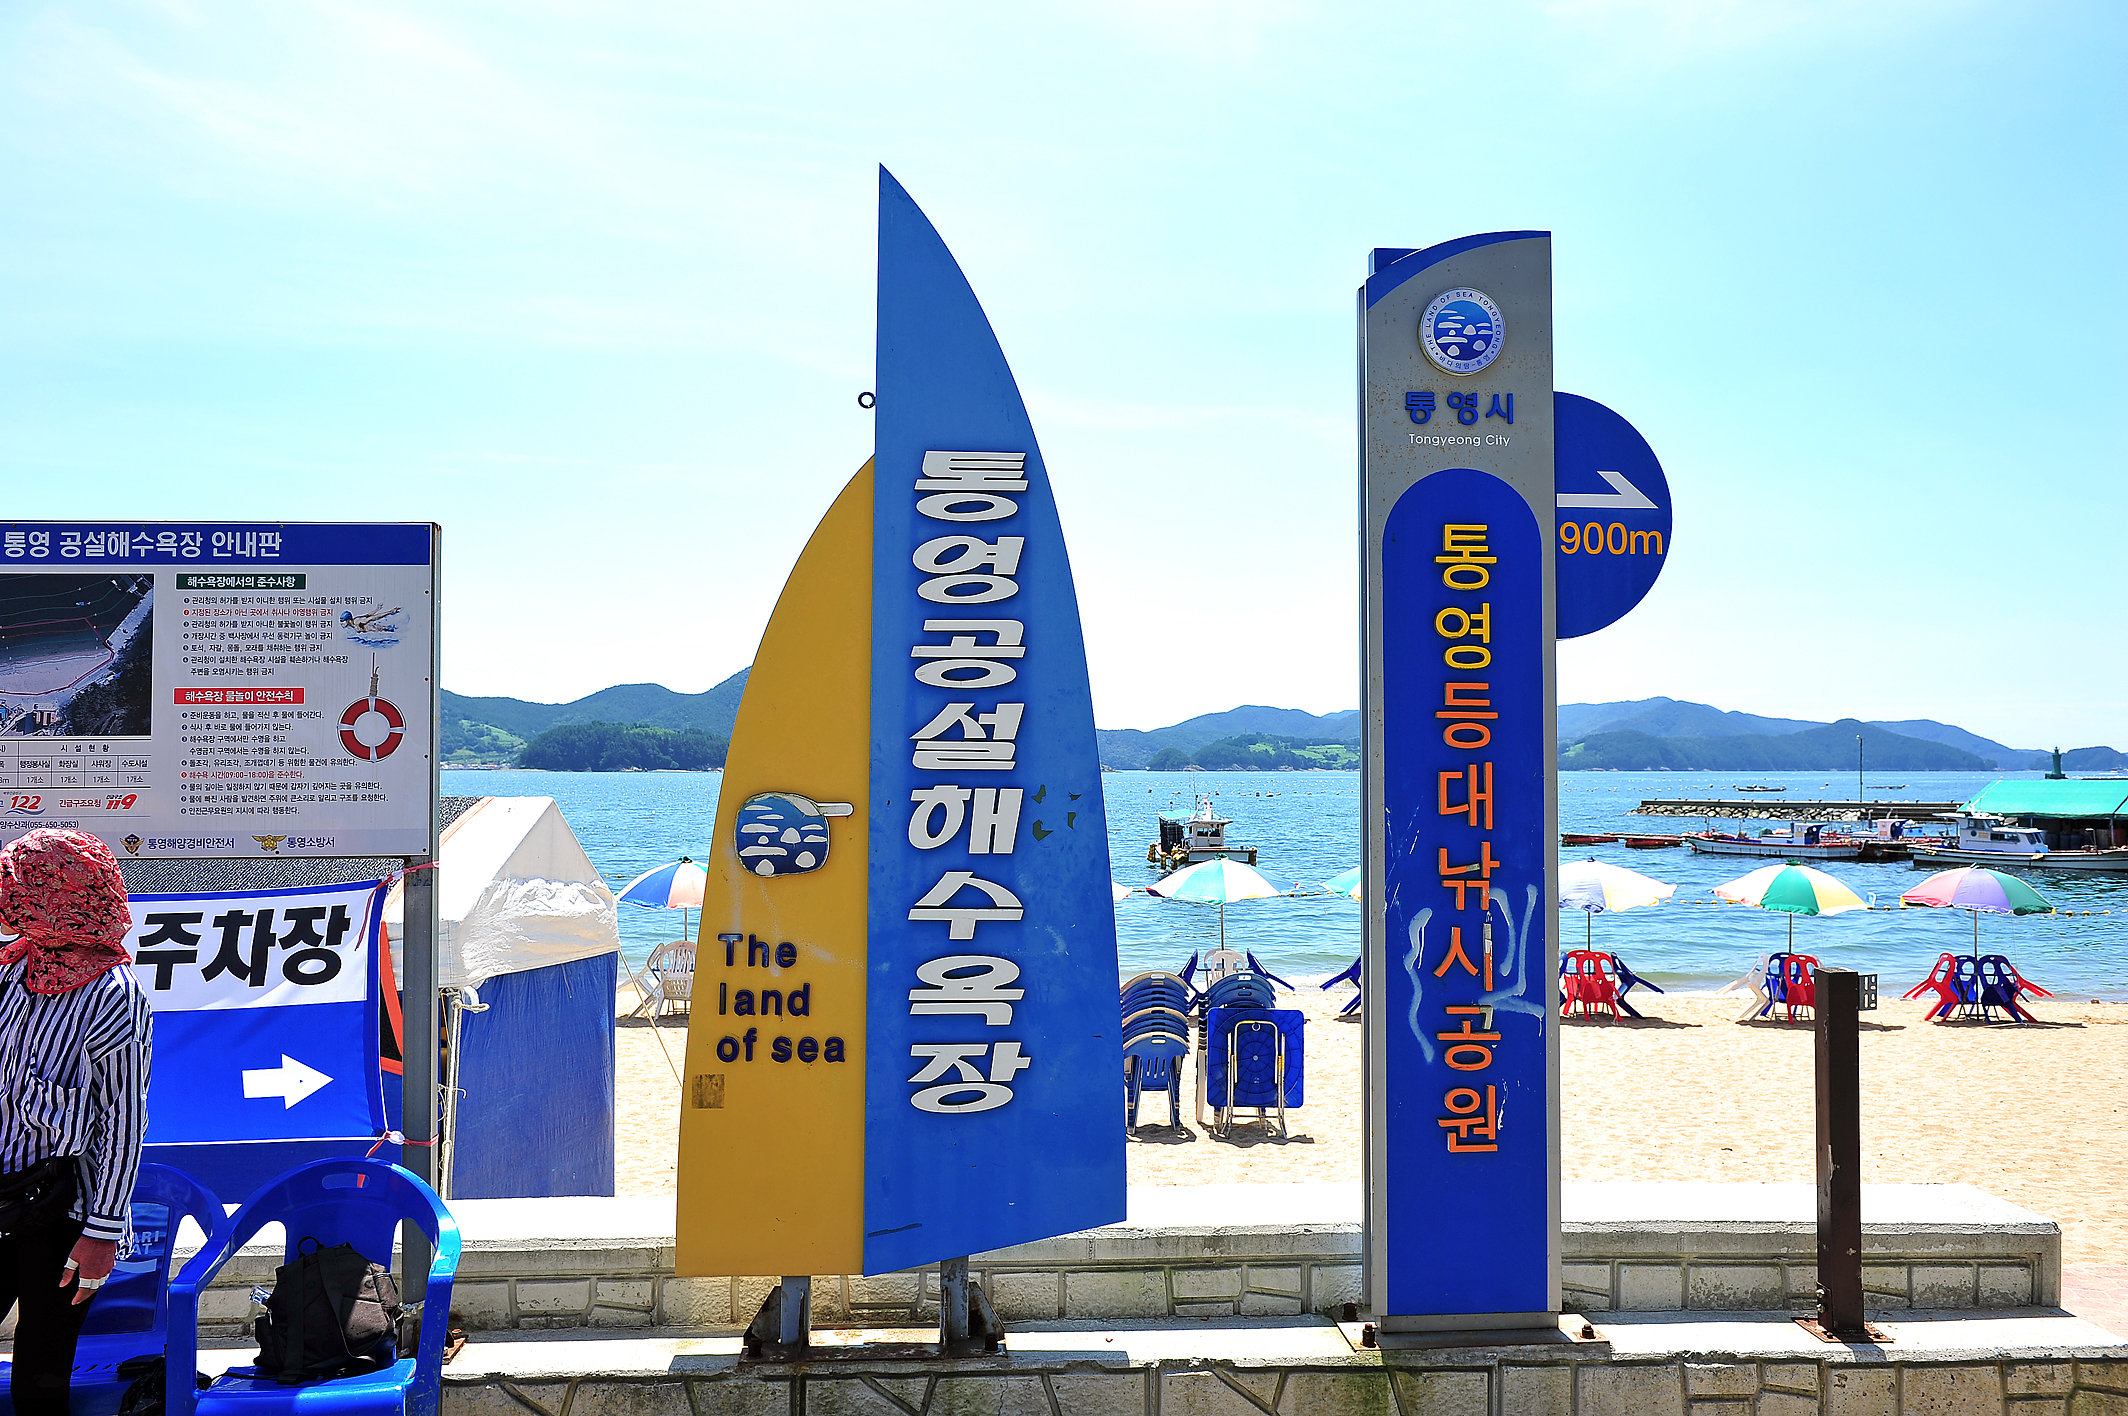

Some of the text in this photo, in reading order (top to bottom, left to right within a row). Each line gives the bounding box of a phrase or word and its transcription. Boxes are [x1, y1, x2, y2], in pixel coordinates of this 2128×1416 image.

[1440, 295, 1451, 303] OF
[1425, 305, 1438, 328] LAND
[1425, 334, 1436, 351] THE
[1405, 391, 1514, 425] 통영시
[1409, 433, 1510, 447] Tongyeong City
[4, 532, 282, 558] 통영 공설해수욕장 안내판
[1559, 522, 1663, 555] 900m
[187, 576, 295, 588] 해수욕장에서의 준수사항
[185, 691, 293, 702] 해수욕장 물놀이 안전수칙
[58, 760, 78, 768] 화장실
[91, 760, 111, 768] 샤워장
[27, 776, 44, 784] 1개소
[60, 776, 77, 784] 1개소
[93, 776, 110, 784] 1개소
[126, 776, 143, 784] 1개소
[908, 451, 1033, 1115] 통영공설해수욕장
[11, 796, 41, 809] 122
[59, 800, 101, 808] 긴급구조요청
[106, 794, 137, 809] 119
[148, 837, 234, 848] 통영해양경비안전서
[287, 837, 335, 848] 통영소방서
[1432, 522, 1502, 1154] 통영등대낚시공원
[136, 904, 351, 991] 주차장
[717, 934, 797, 968] The
[718, 983, 810, 1017] land
[716, 1028, 845, 1063] of sea
